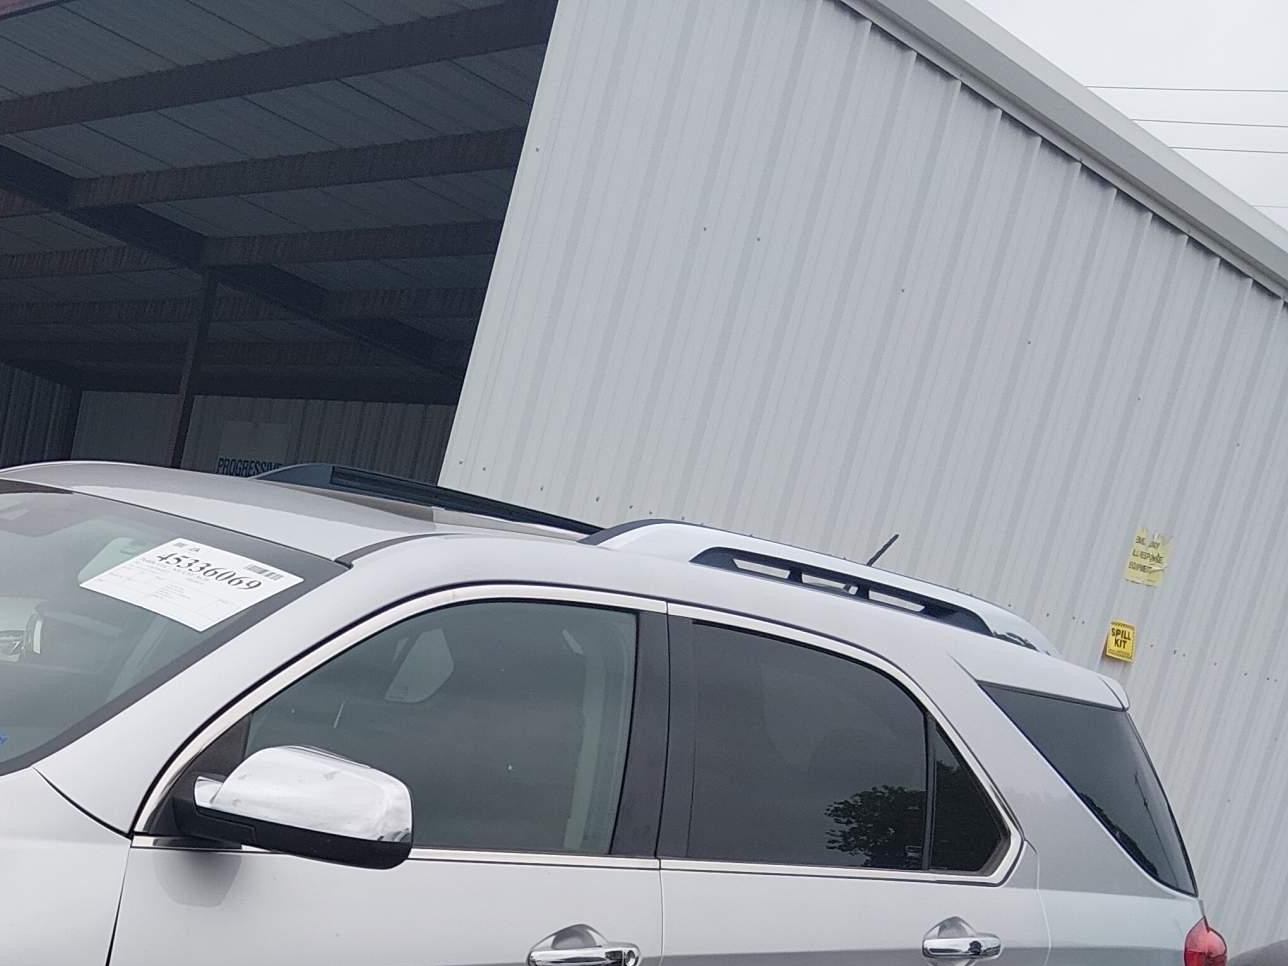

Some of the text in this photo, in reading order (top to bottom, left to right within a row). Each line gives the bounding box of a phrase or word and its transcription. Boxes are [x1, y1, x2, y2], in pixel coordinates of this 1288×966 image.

[216, 457, 283, 478] PROGRESSI
[156, 552, 262, 590] 45336069
[1111, 627, 1131, 640] SPILL
[1114, 637, 1127, 648] KIT
